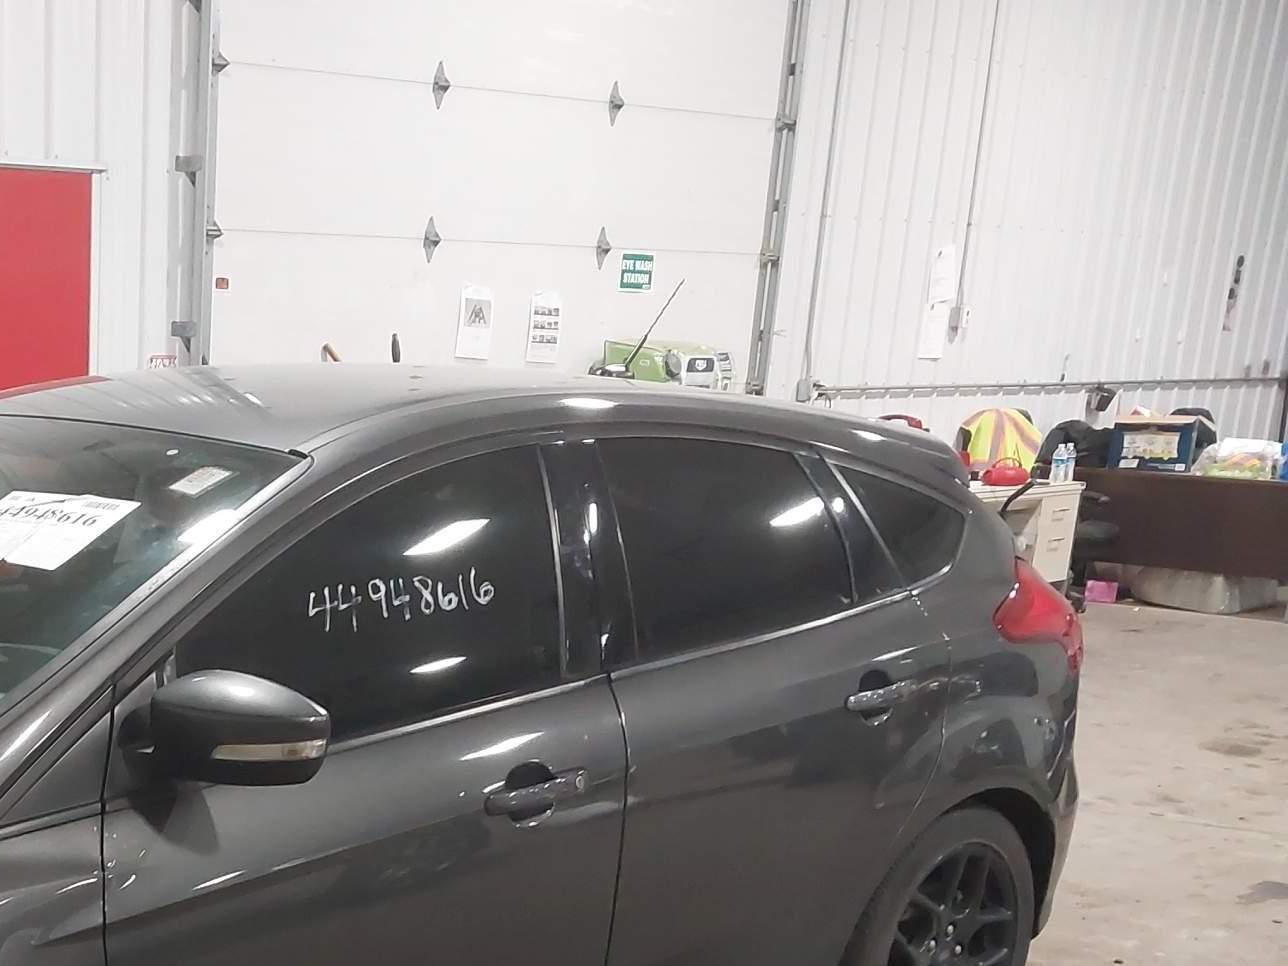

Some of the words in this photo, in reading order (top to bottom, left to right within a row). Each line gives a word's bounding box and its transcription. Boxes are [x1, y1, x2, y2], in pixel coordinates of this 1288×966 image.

[622, 259, 634, 270] EYE
[623, 272, 649, 283] STATION
[308, 566, 495, 632] 44948616
